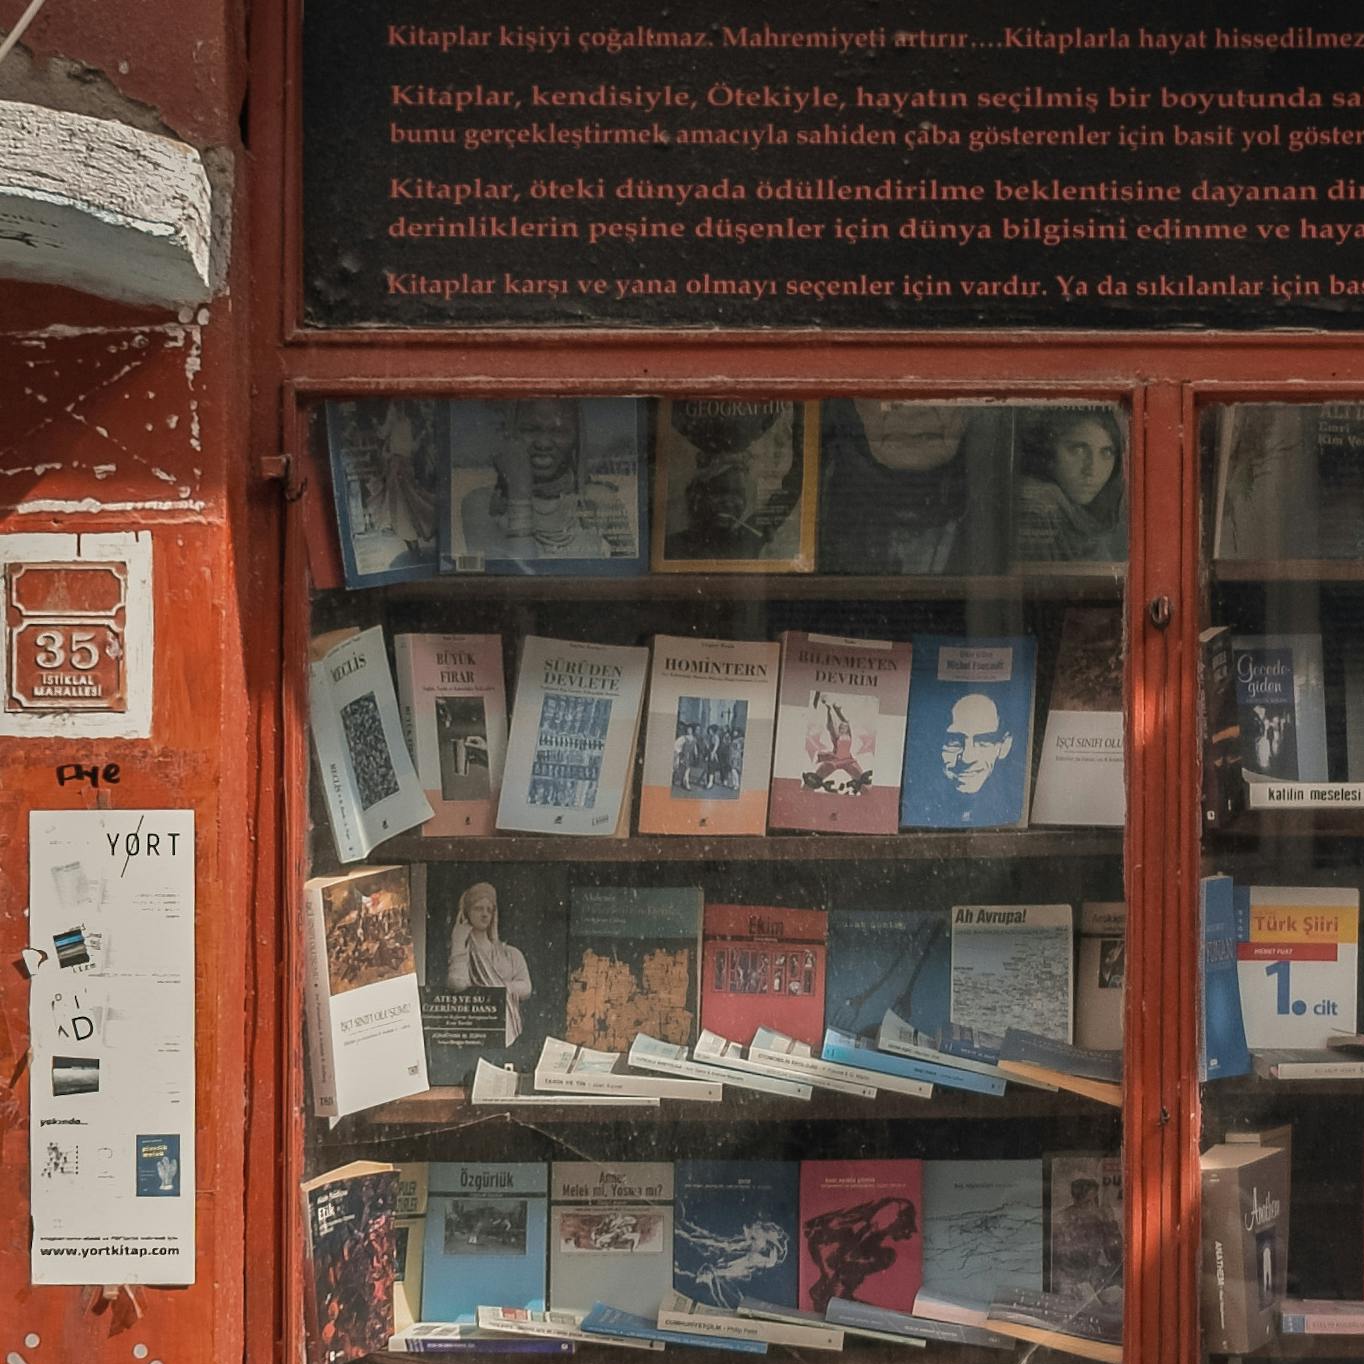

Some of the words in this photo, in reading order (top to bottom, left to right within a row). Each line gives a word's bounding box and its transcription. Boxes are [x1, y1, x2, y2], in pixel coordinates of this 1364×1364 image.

[387, 25, 491, 53] Kitaplar
[499, 25, 571, 53] kişiyi
[578, 25, 714, 53] çoğaltmaz.
[722, 25, 887, 53] Mahremiyeti
[1139, 27, 1207, 53] hayat
[391, 84, 521, 112] Kitaplar,
[532, 84, 697, 113] kendisiyle,
[706, 82, 846, 113] Ötekiyle,
[856, 85, 968, 113] hayatın
[977, 86, 1099, 113] seçilmiş
[1109, 86, 1152, 108] bir
[1161, 86, 1323, 114] boyutunda
[390, 122, 456, 144] bunu
[464, 122, 670, 150] gerçekleştirmek
[675, 123, 789, 151] amacıyla
[796, 123, 897, 145] sahiden
[904, 122, 961, 150] çaba
[968, 124, 1111, 152] gösterenler
[1118, 124, 1165, 151] için
[1173, 124, 1234, 146] basit
[1242, 124, 1281, 152] yol
[390, 177, 521, 205] Kitaplar,
[529, 177, 605, 199] öteki
[615, 177, 746, 206] dünyada
[755, 178, 985, 201] ödüllendirilme
[994, 178, 1182, 202] beklentisine
[1191, 179, 1318, 208] dayanan
[388, 216, 579, 238] derinliklerin
[588, 216, 686, 244] peşine
[694, 216, 826, 244] düşenler
[834, 217, 890, 245] için
[898, 217, 993, 246] dünya
[1002, 217, 1127, 246] bilgisini
[1136, 218, 1248, 241] edinme
[1256, 224, 1291, 240] ve
[386, 271, 496, 301] Kitaplar
[504, 272, 569, 298] karşı
[577, 278, 609, 294] ve
[615, 279, 677, 299] yana
[685, 273, 777, 300] olmayı
[786, 274, 896, 300] seçenler
[903, 274, 952, 301] için
[959, 274, 1047, 298] vardır.
[1055, 275, 1089, 300] Ya
[1096, 274, 1128, 296] da
[1136, 274, 1264, 297] sıkılanlar
[1271, 274, 1321, 302] için
[34, 630, 99, 670] 35
[544, 658, 623, 677] SÜRÜDEN
[665, 656, 768, 677] HOMİNTERN
[814, 669, 879, 687] DEVRİM
[543, 673, 620, 691] DEVLETE
[1310, 786, 1362, 803] meselesi
[955, 908, 974, 924] Ah
[976, 908, 1026, 925] Avrupa!
[1254, 914, 1297, 933] Türk
[1302, 914, 1339, 936] Şiiri
[1265, 960, 1307, 1016] 1.
[1313, 1000, 1338, 1016] cilt
[460, 1168, 514, 1191] Özgürlük
